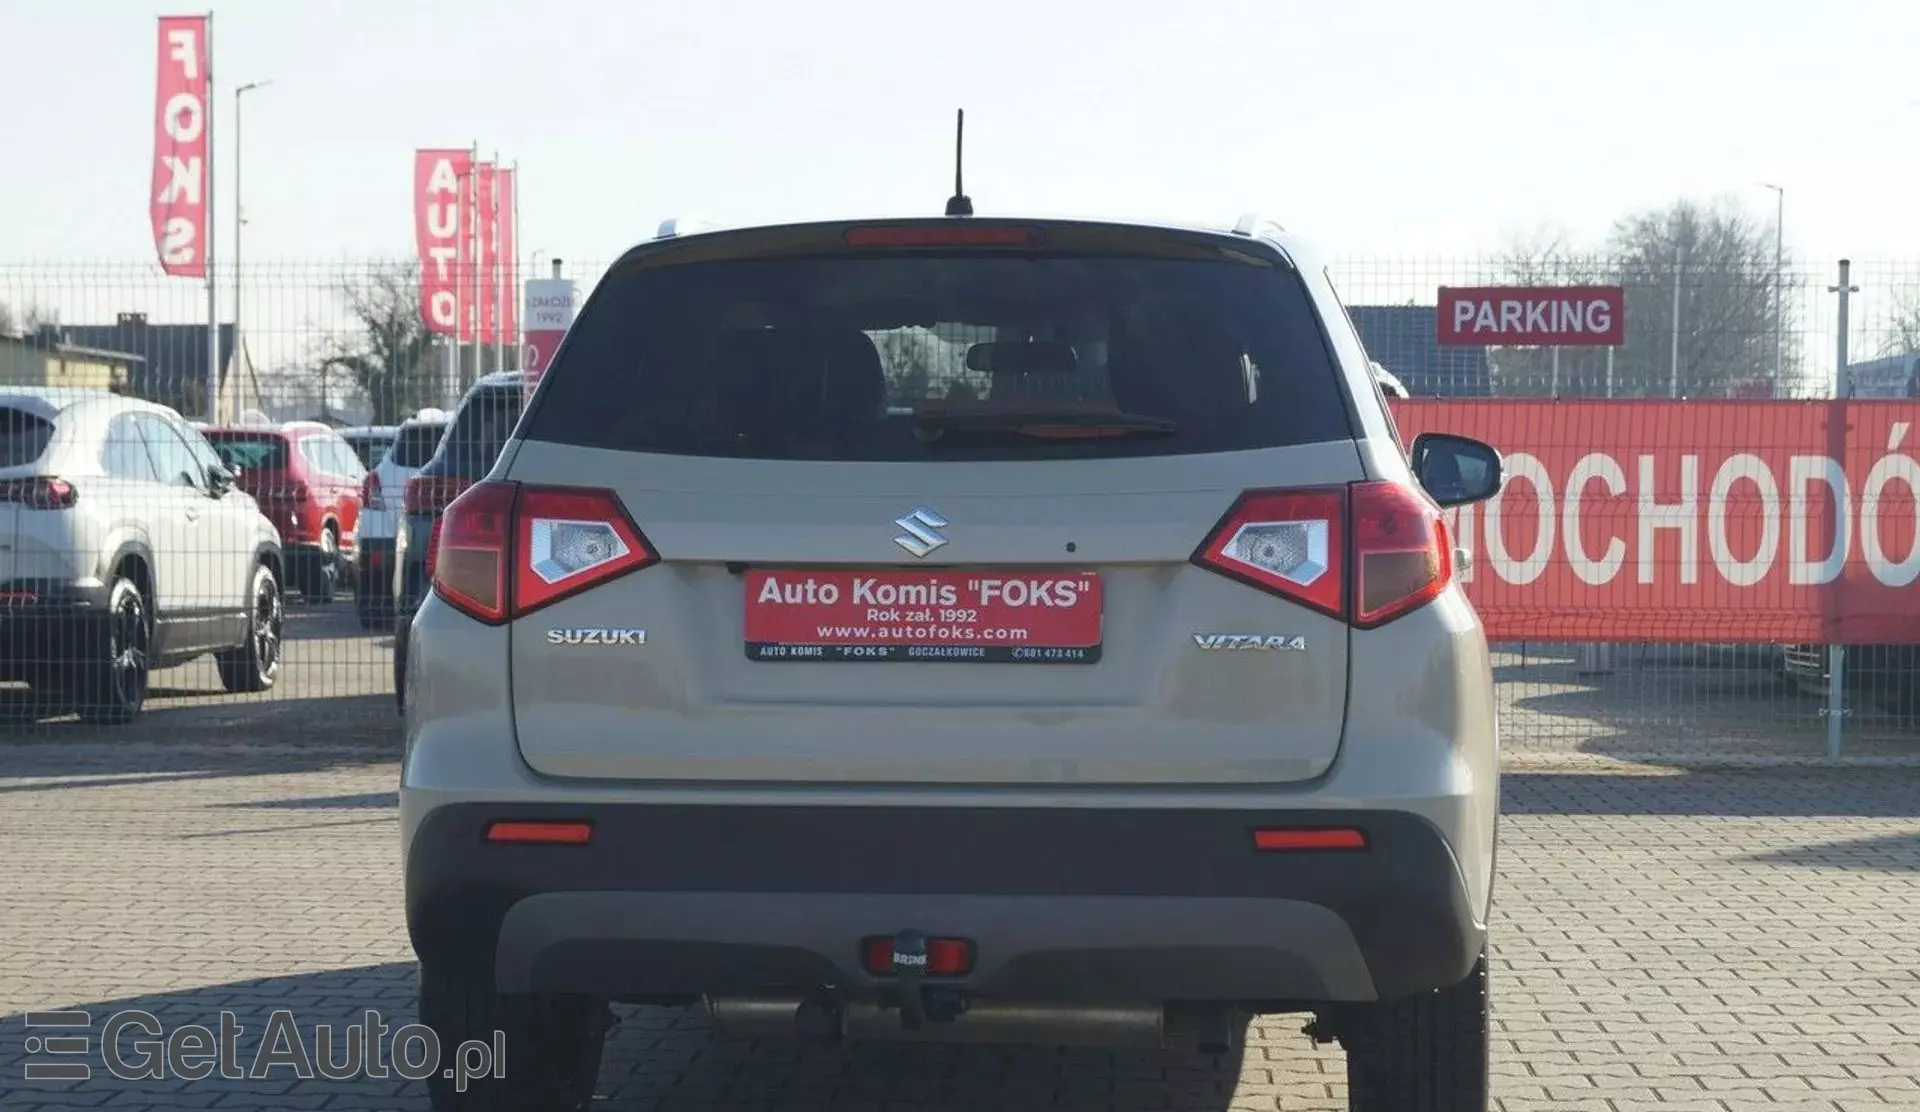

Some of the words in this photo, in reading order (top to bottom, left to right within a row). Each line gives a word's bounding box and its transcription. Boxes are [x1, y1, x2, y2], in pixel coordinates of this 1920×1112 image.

[427, 157, 458, 328] AUTO
[1452, 298, 1613, 334] PARKING
[758, 577, 839, 605] Auto
[852, 578, 957, 606] Komis
[967, 578, 1091, 608] "FOKS"
[866, 608, 900, 622] Rok
[940, 609, 977, 623] 1992
[546, 627, 648, 645] SUZUKI
[816, 624, 1029, 641] www.autofoks.com
[1192, 633, 1306, 651] VITARA
[760, 646, 786, 657] AUTO
[790, 646, 823, 657] KOMIS
